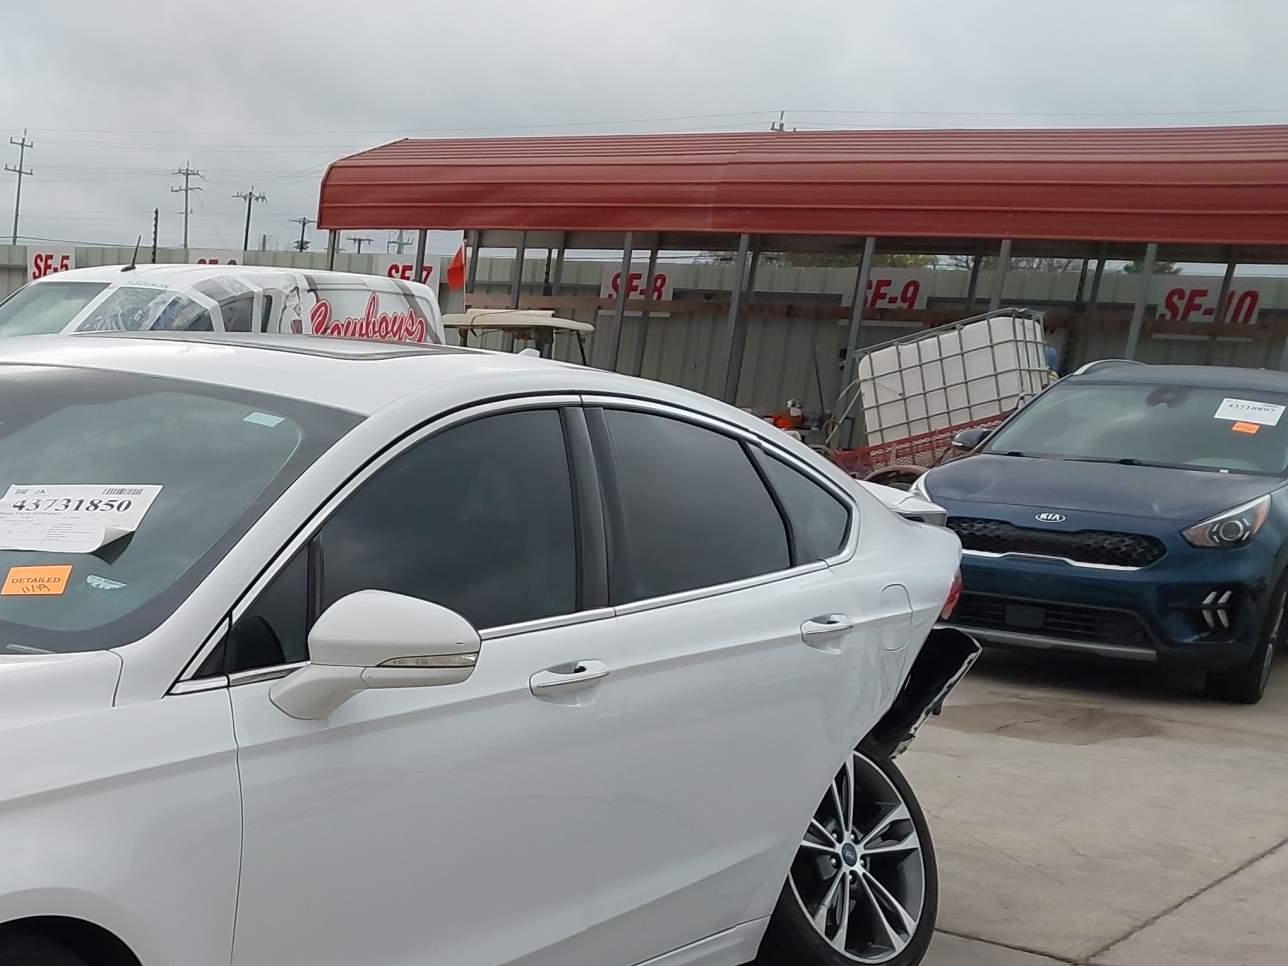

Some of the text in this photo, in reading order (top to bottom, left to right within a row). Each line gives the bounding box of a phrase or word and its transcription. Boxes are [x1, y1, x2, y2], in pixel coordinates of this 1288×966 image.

[32, 254, 70, 280] SF-5
[863, 279, 920, 309] F-9
[310, 289, 427, 343] Cowboys
[12, 498, 132, 512] 43731850
[1039, 512, 1060, 521] KIA
